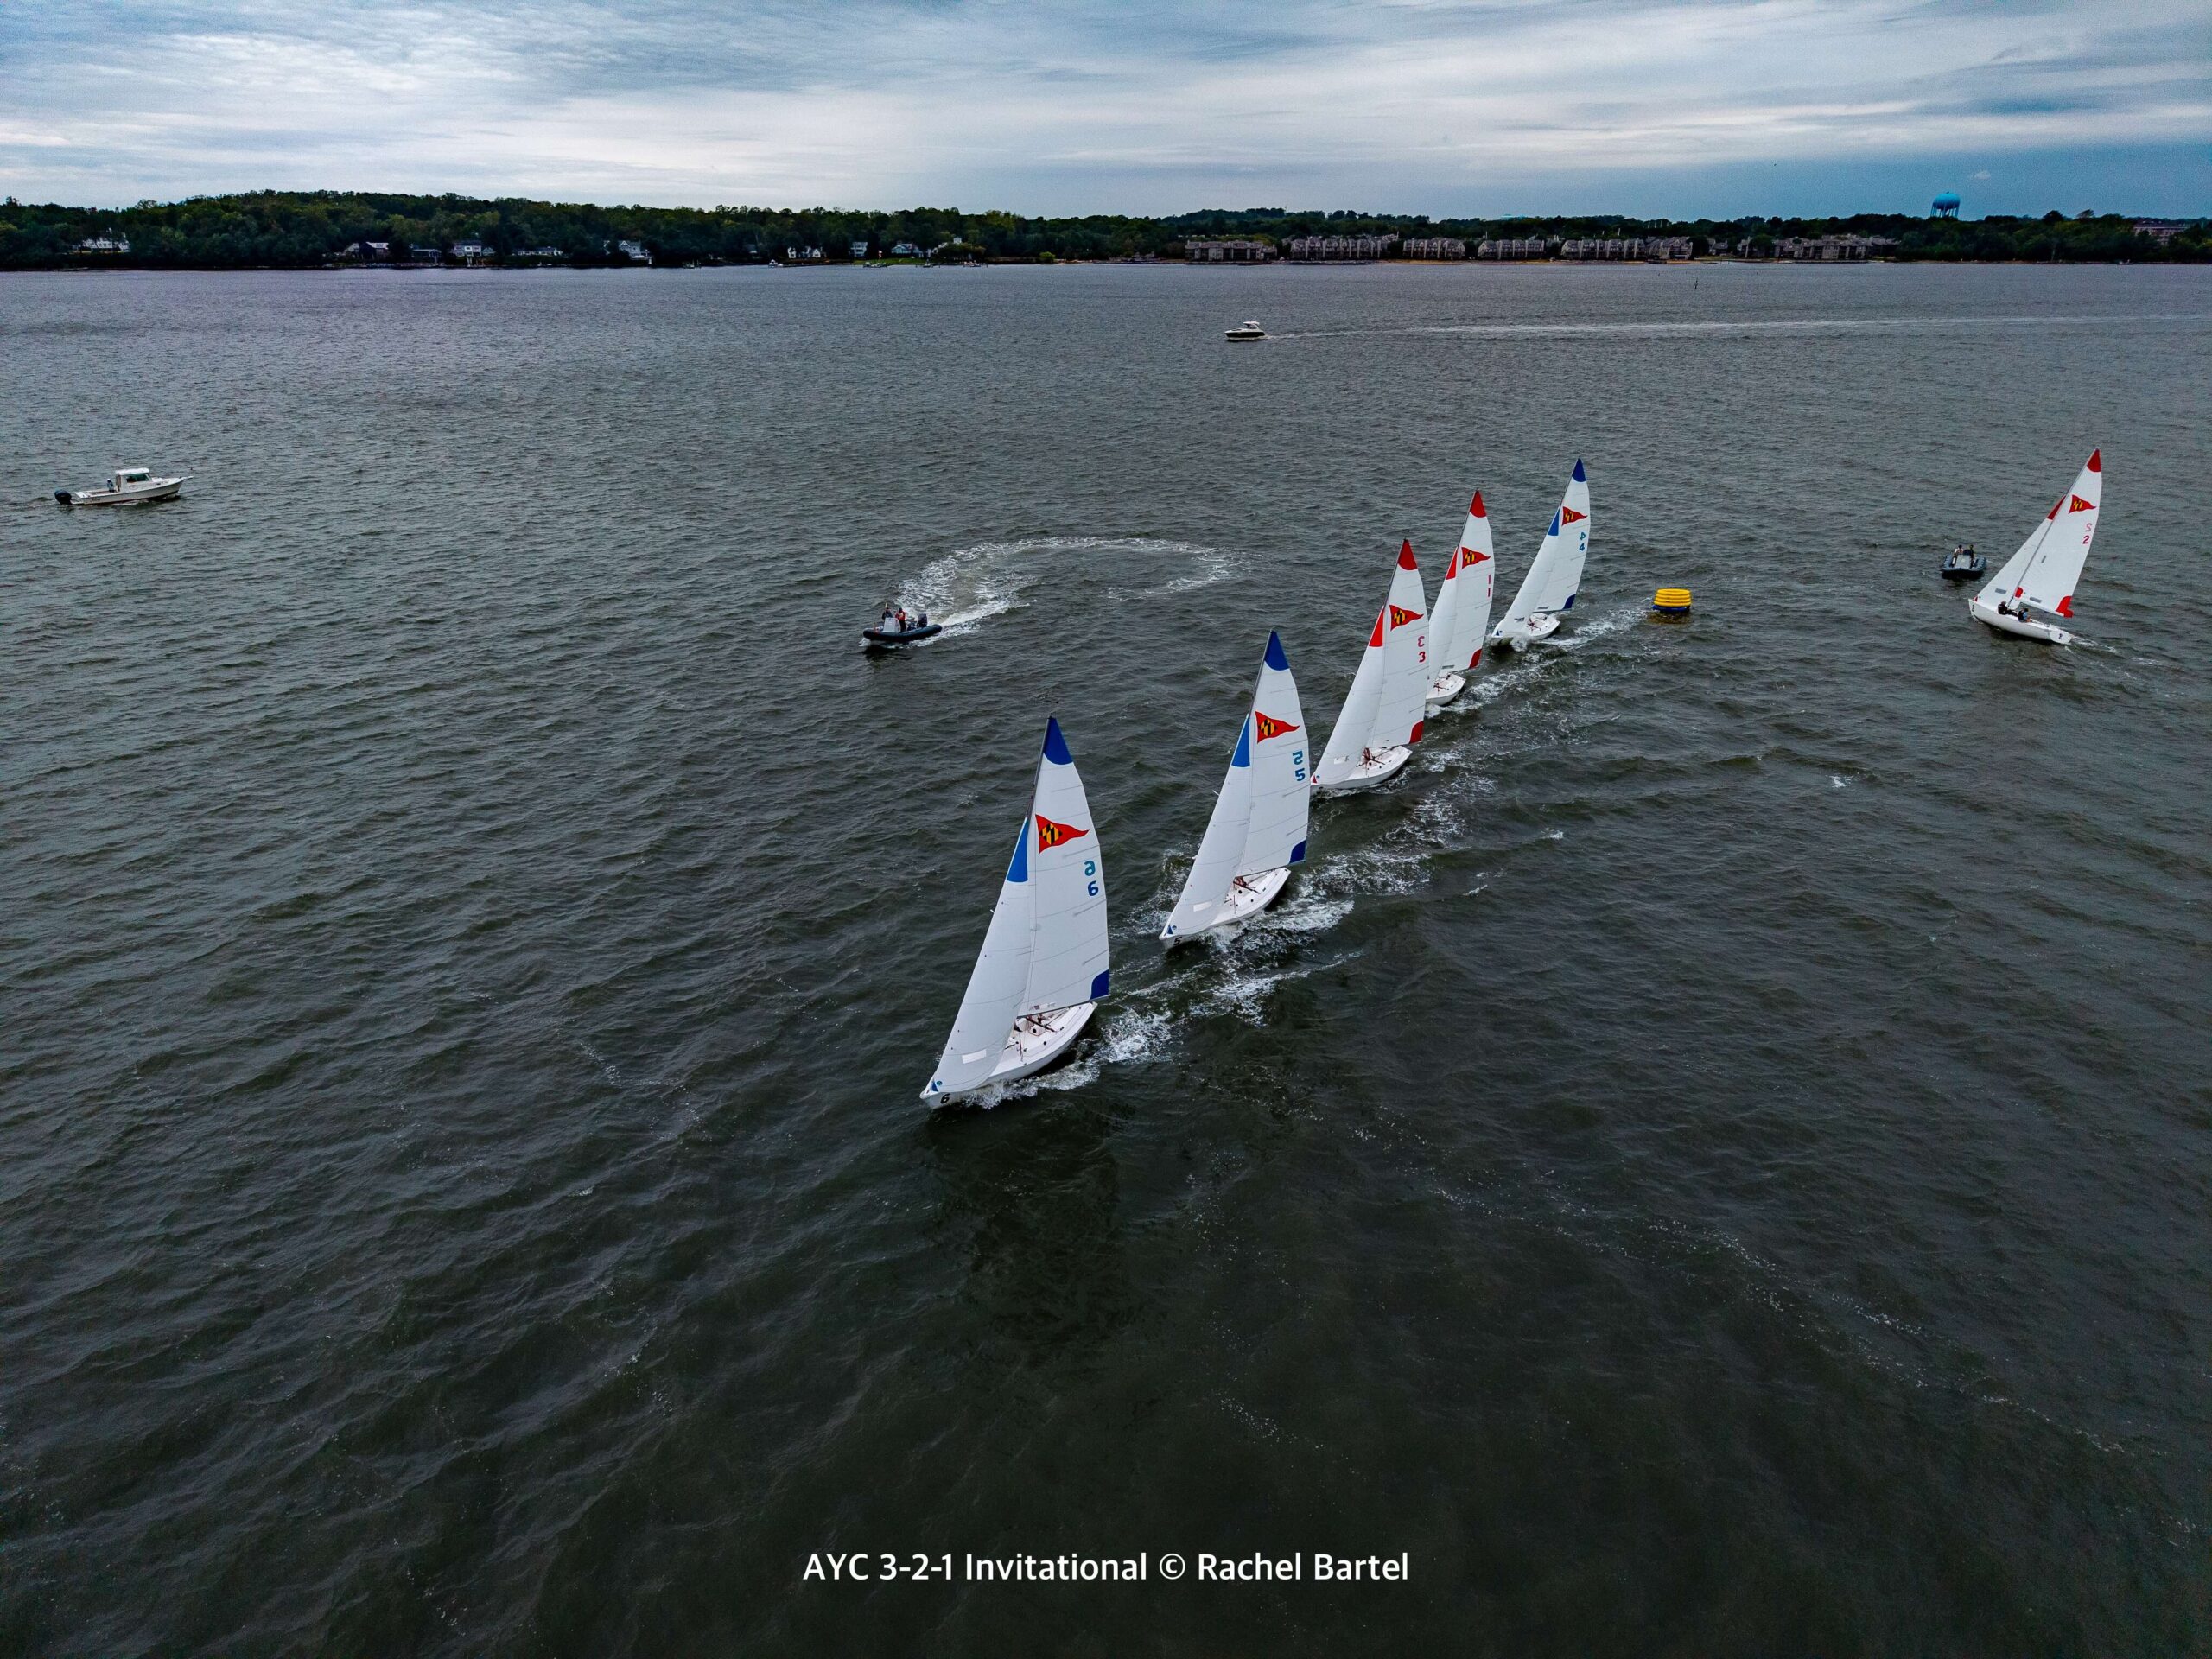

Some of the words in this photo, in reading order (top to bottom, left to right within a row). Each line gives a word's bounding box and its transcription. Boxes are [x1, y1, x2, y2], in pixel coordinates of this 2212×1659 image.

[2082, 535, 2090, 544] 2
[1579, 543, 1586, 551] 4
[1418, 651, 1426, 663] 3
[1294, 768, 1306, 781] 5
[1087, 880, 1099, 896] 6
[1174, 936, 1183, 946] 5
[940, 1093, 950, 1104] 6
